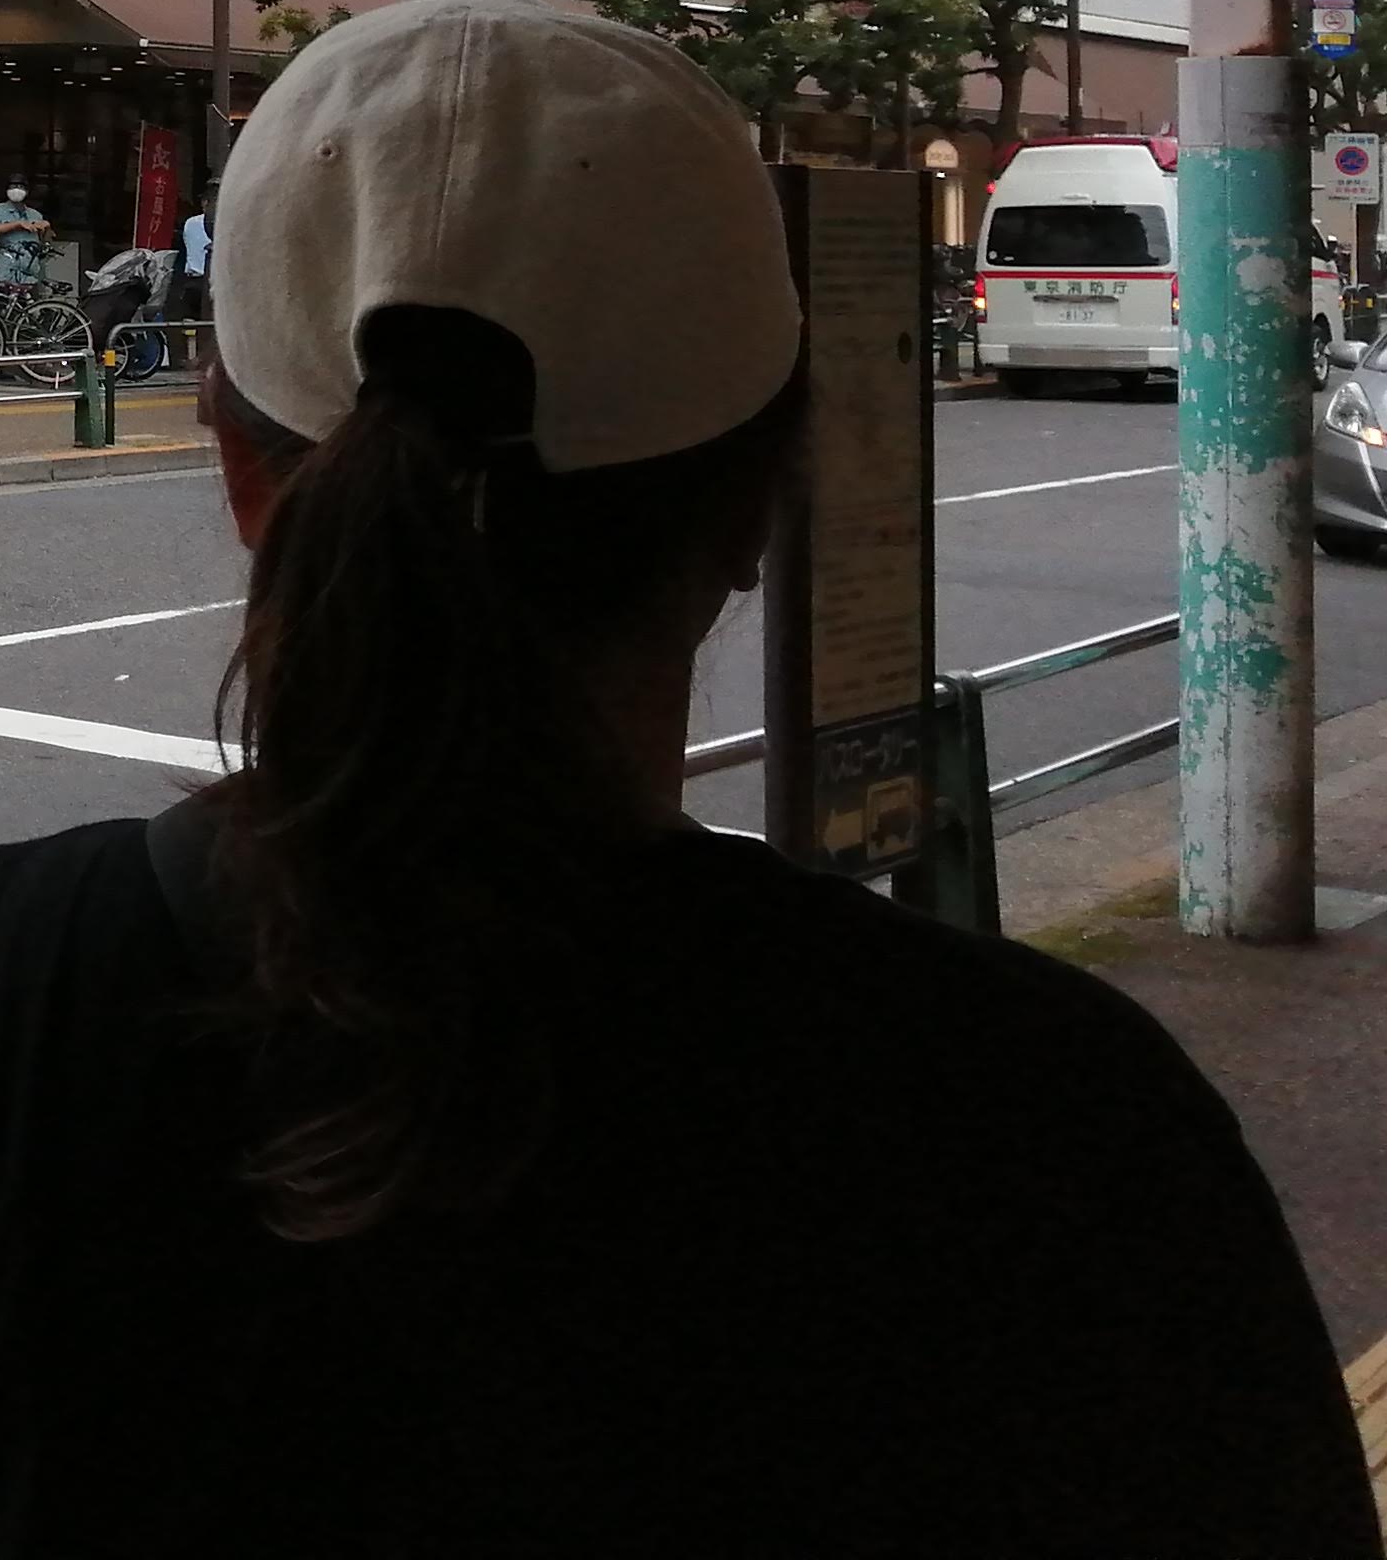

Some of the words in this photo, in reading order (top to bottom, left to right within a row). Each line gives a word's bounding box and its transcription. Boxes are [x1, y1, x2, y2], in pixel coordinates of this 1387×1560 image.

[1024, 280, 1128, 295] 東京消防庁
